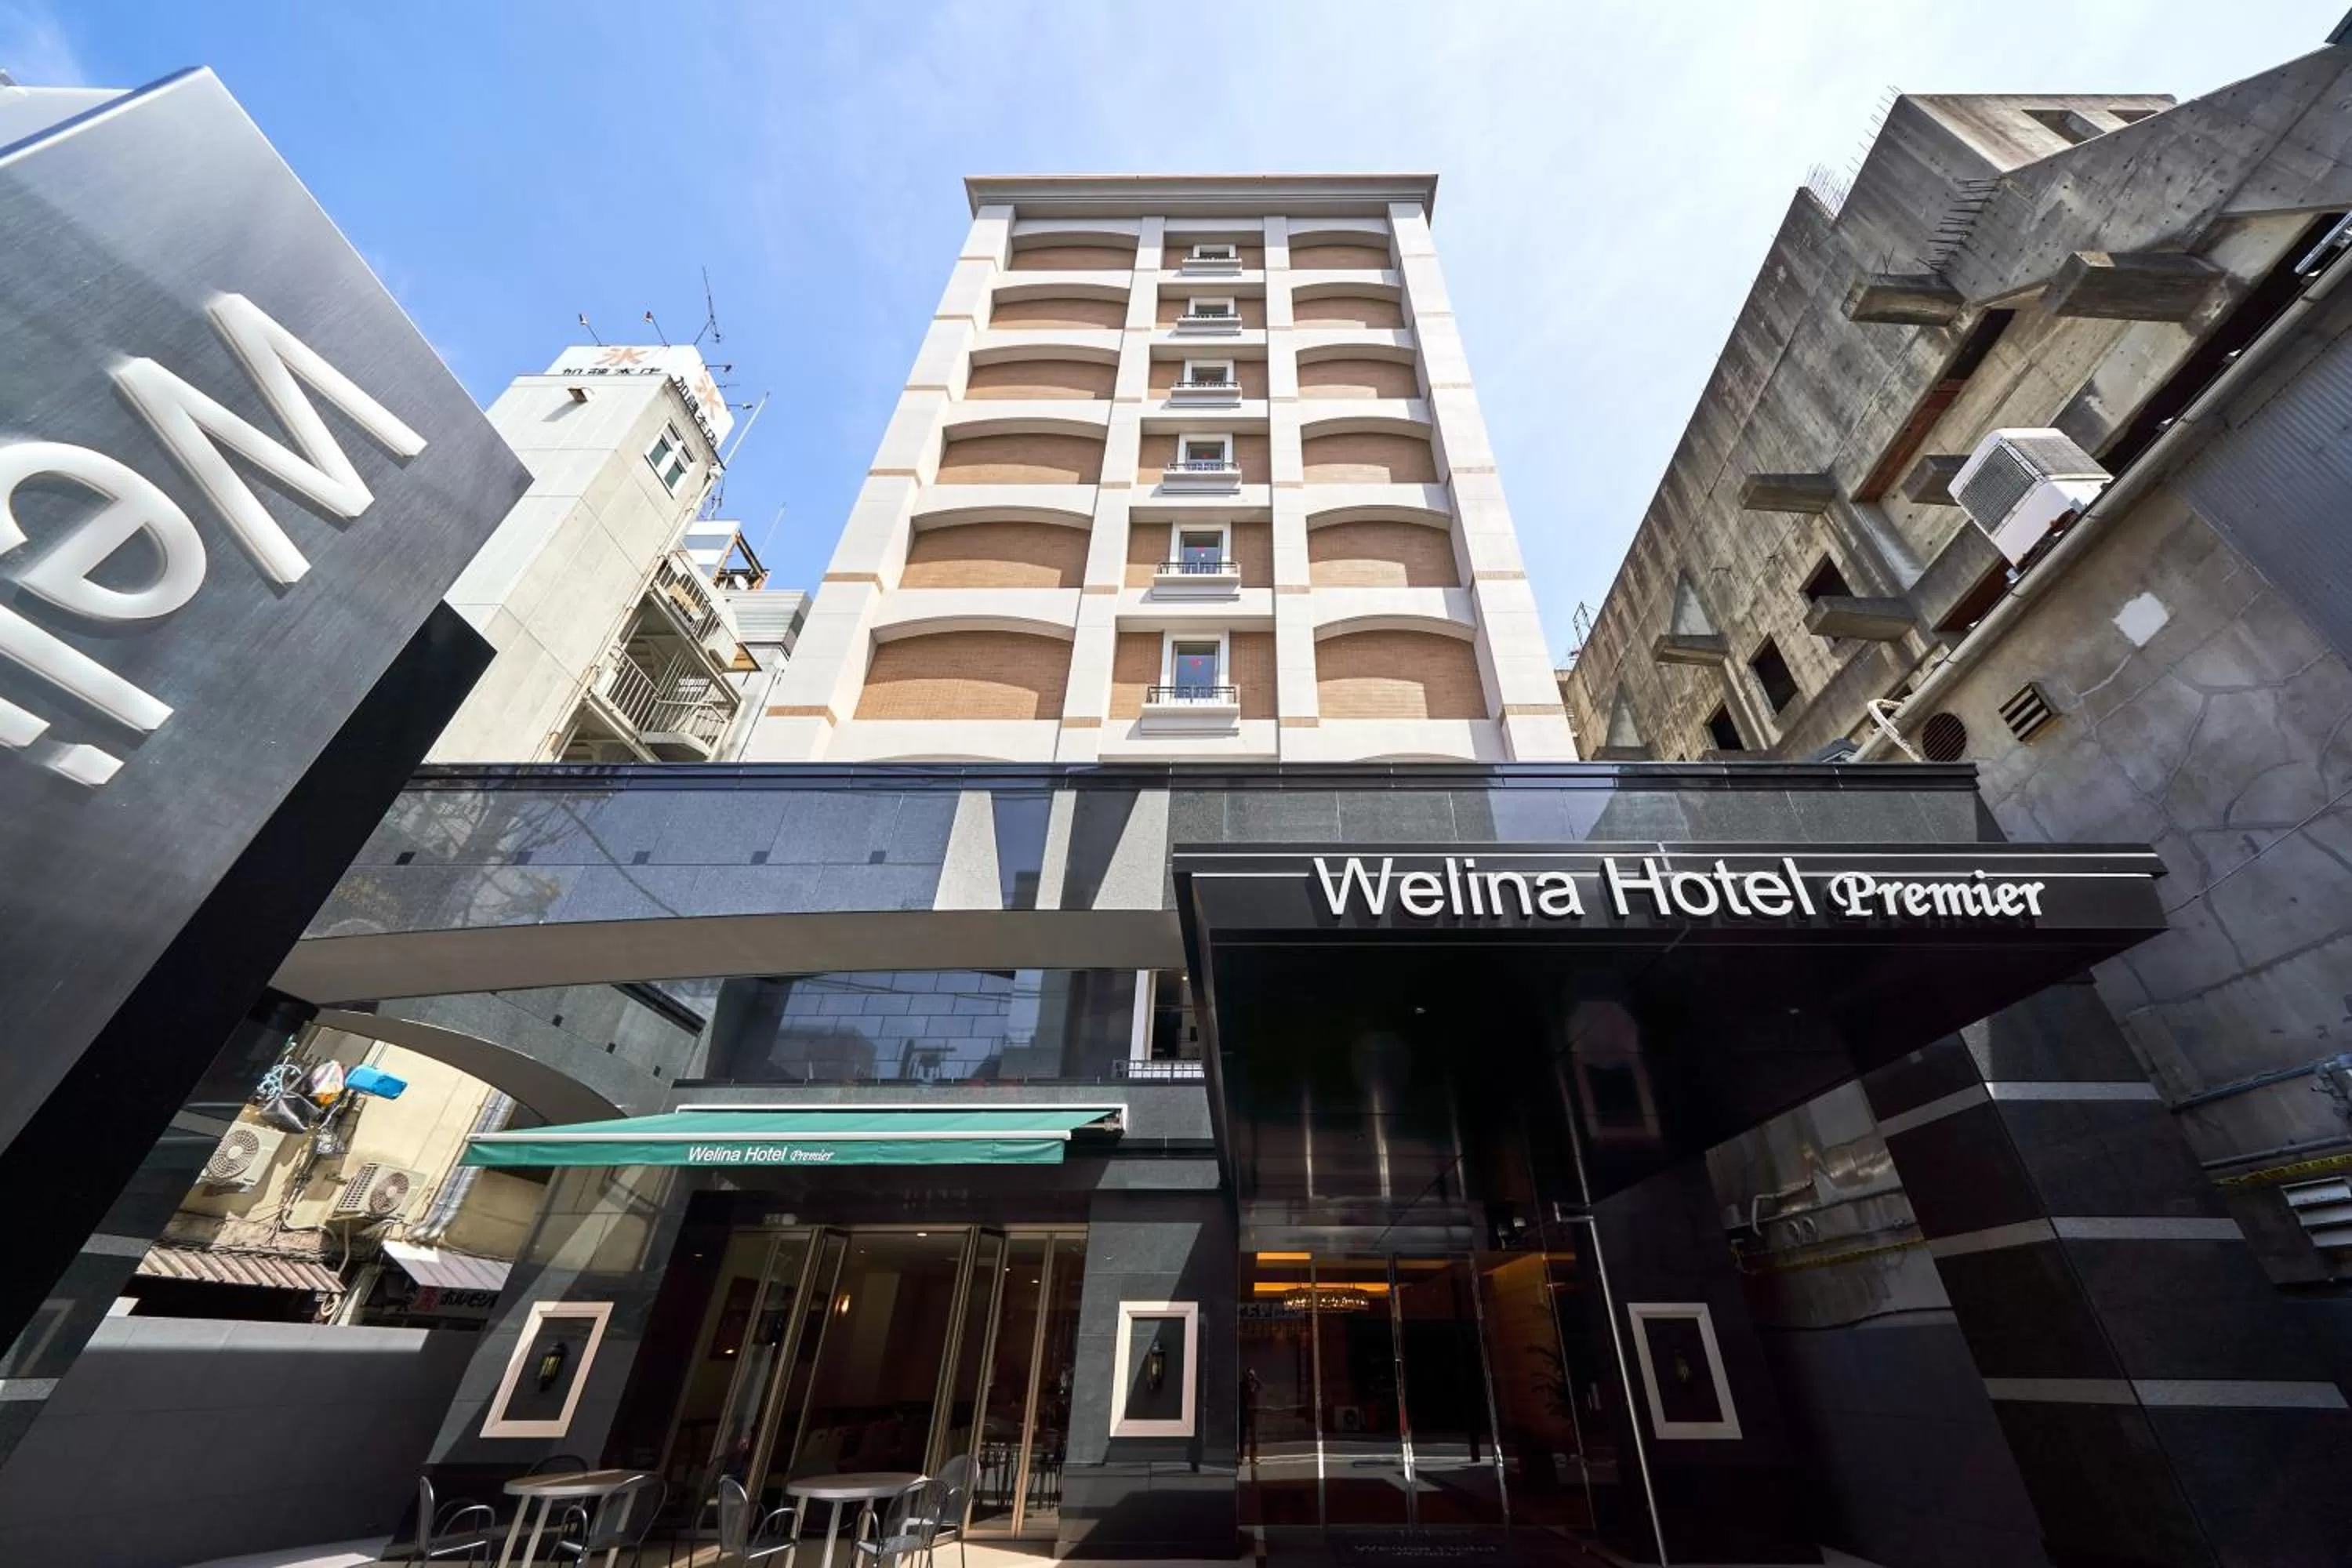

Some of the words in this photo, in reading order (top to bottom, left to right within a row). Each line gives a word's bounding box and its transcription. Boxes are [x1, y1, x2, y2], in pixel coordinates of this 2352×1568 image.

[1314, 858, 1585, 916] Welina
[1604, 858, 1817, 916] Hotel
[1831, 869, 2045, 916] Premier
[689, 1146, 742, 1161] Welina
[745, 1146, 787, 1161] Hotel
[789, 1149, 835, 1161] Premier
